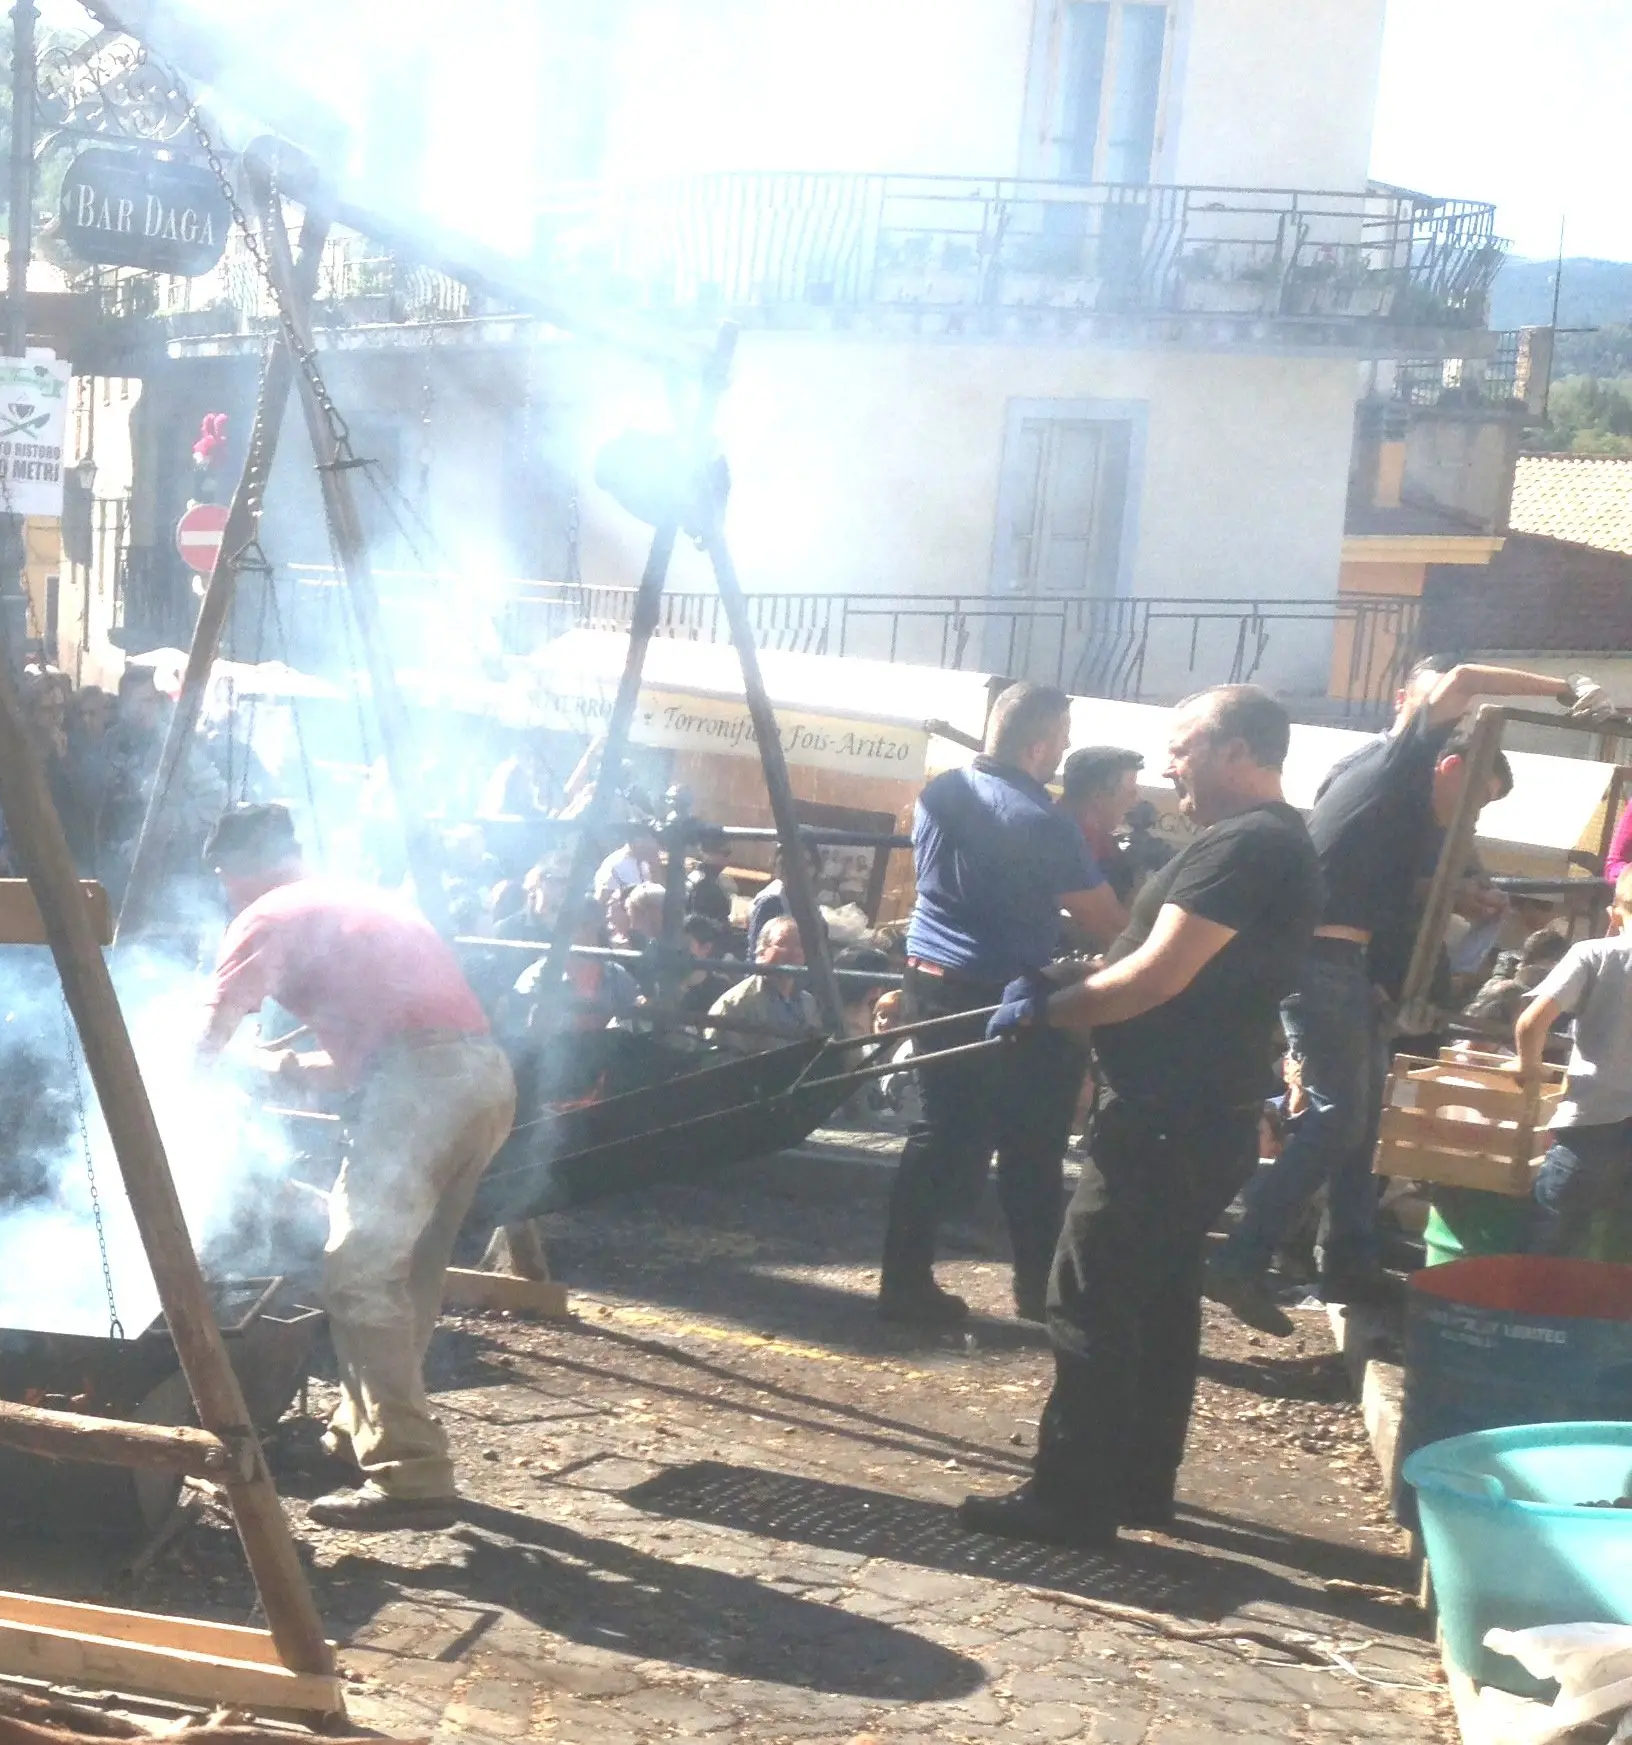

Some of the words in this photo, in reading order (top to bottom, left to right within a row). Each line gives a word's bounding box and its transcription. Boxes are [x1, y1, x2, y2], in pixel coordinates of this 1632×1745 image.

[76, 183, 133, 233] BAR
[144, 193, 216, 247] DAGA
[11, 458, 60, 482] METRI
